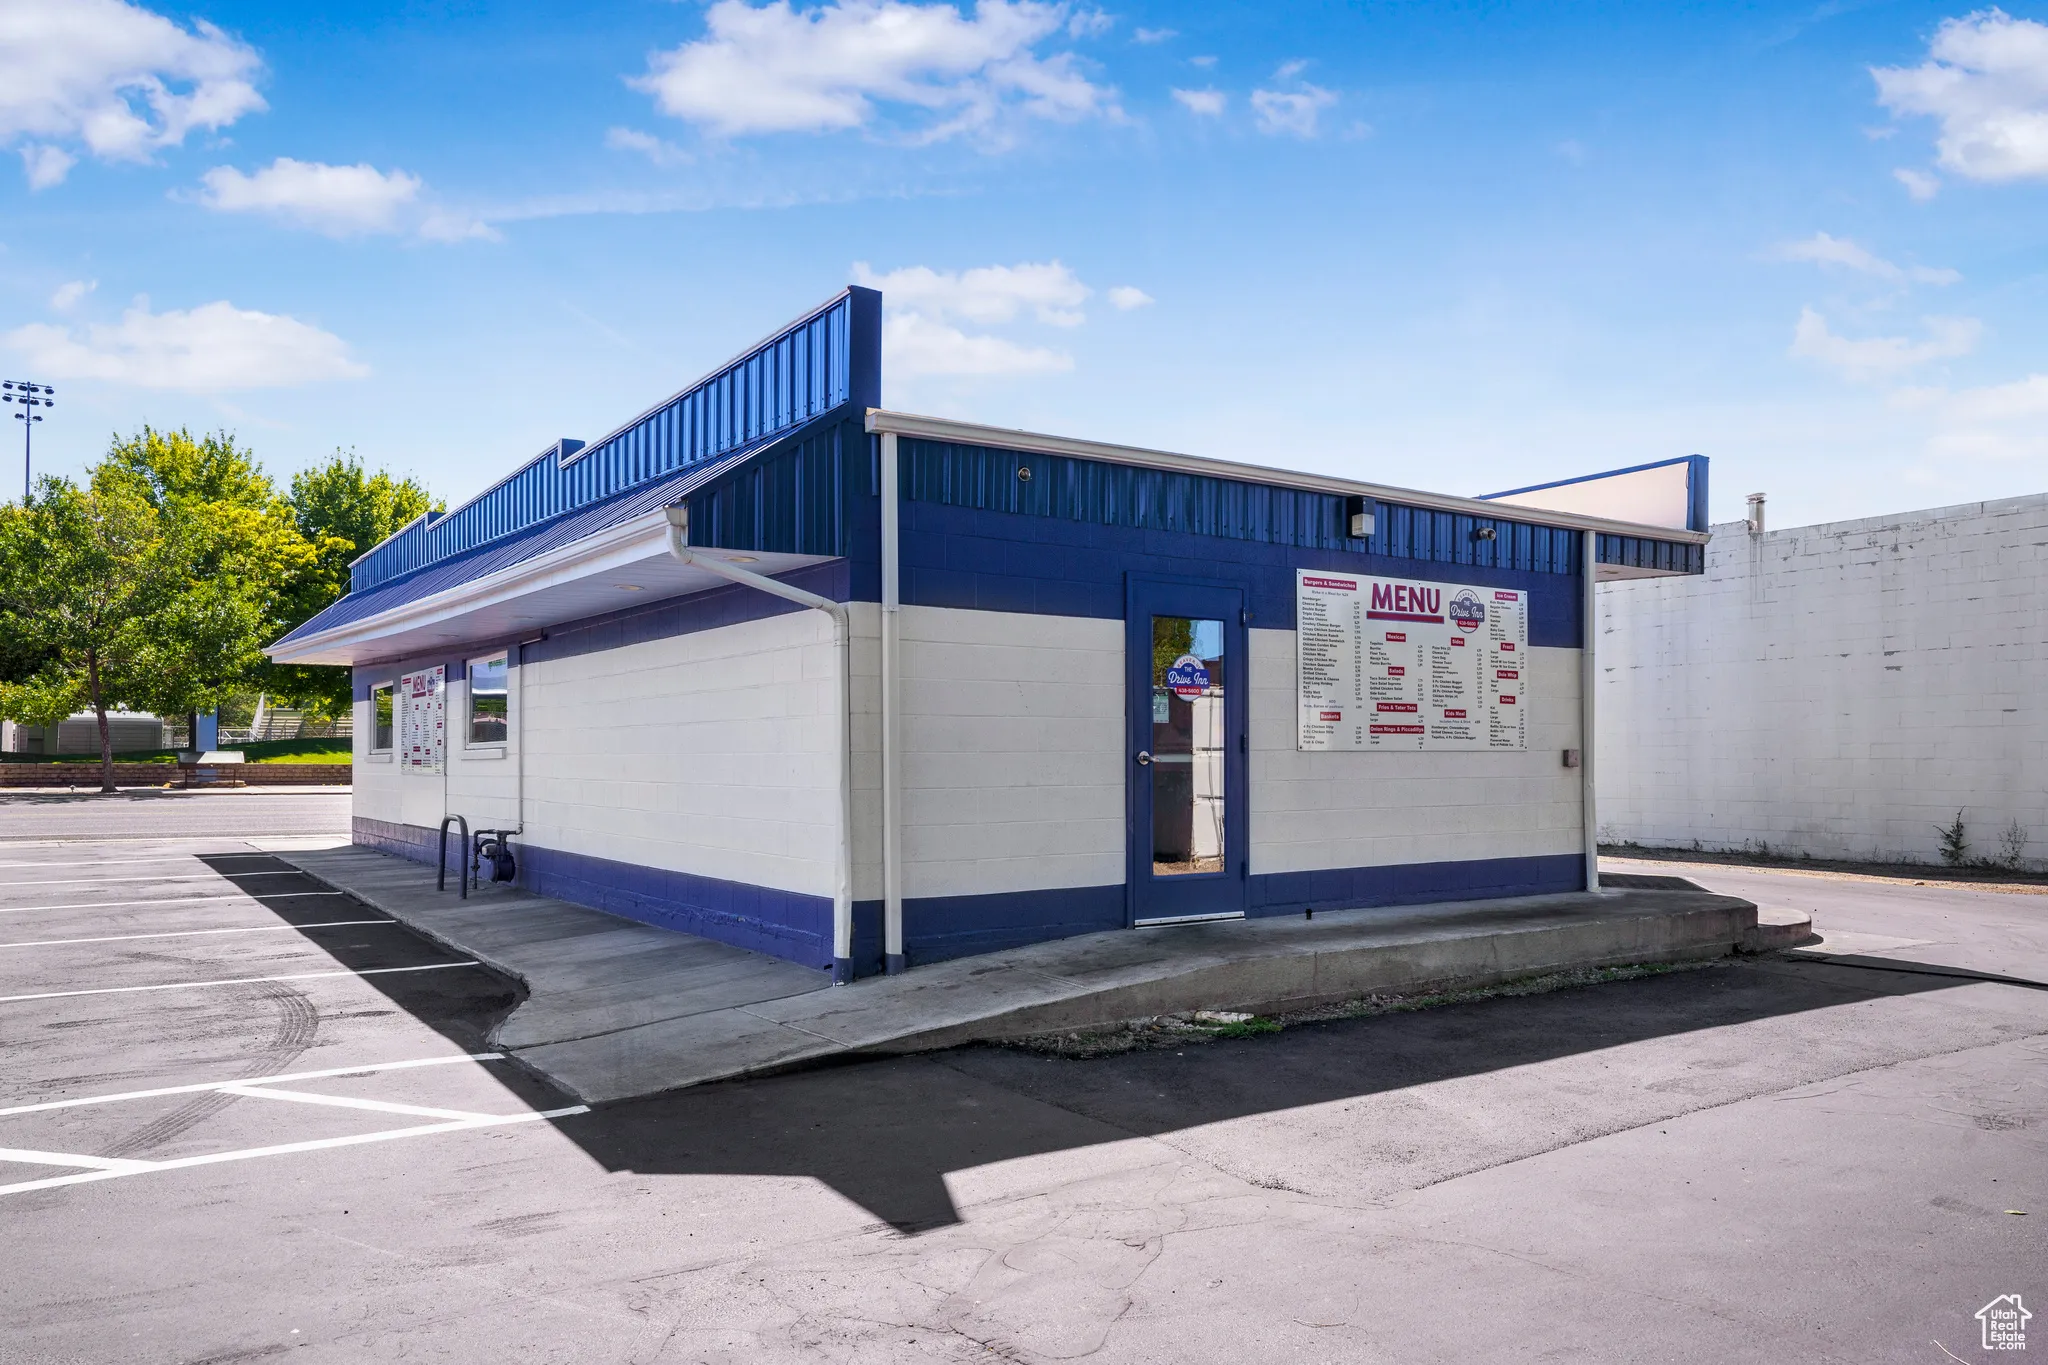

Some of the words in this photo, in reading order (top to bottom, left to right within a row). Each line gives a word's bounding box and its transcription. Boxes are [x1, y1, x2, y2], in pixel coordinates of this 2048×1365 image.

[1371, 583, 1440, 614] MENU
[1450, 605, 1470, 617] Drive
[1471, 606, 1484, 618] Inn
[413, 674, 426, 692] MENU
[1168, 671, 1192, 684] Drive
[1194, 672, 1208, 685] Inn
